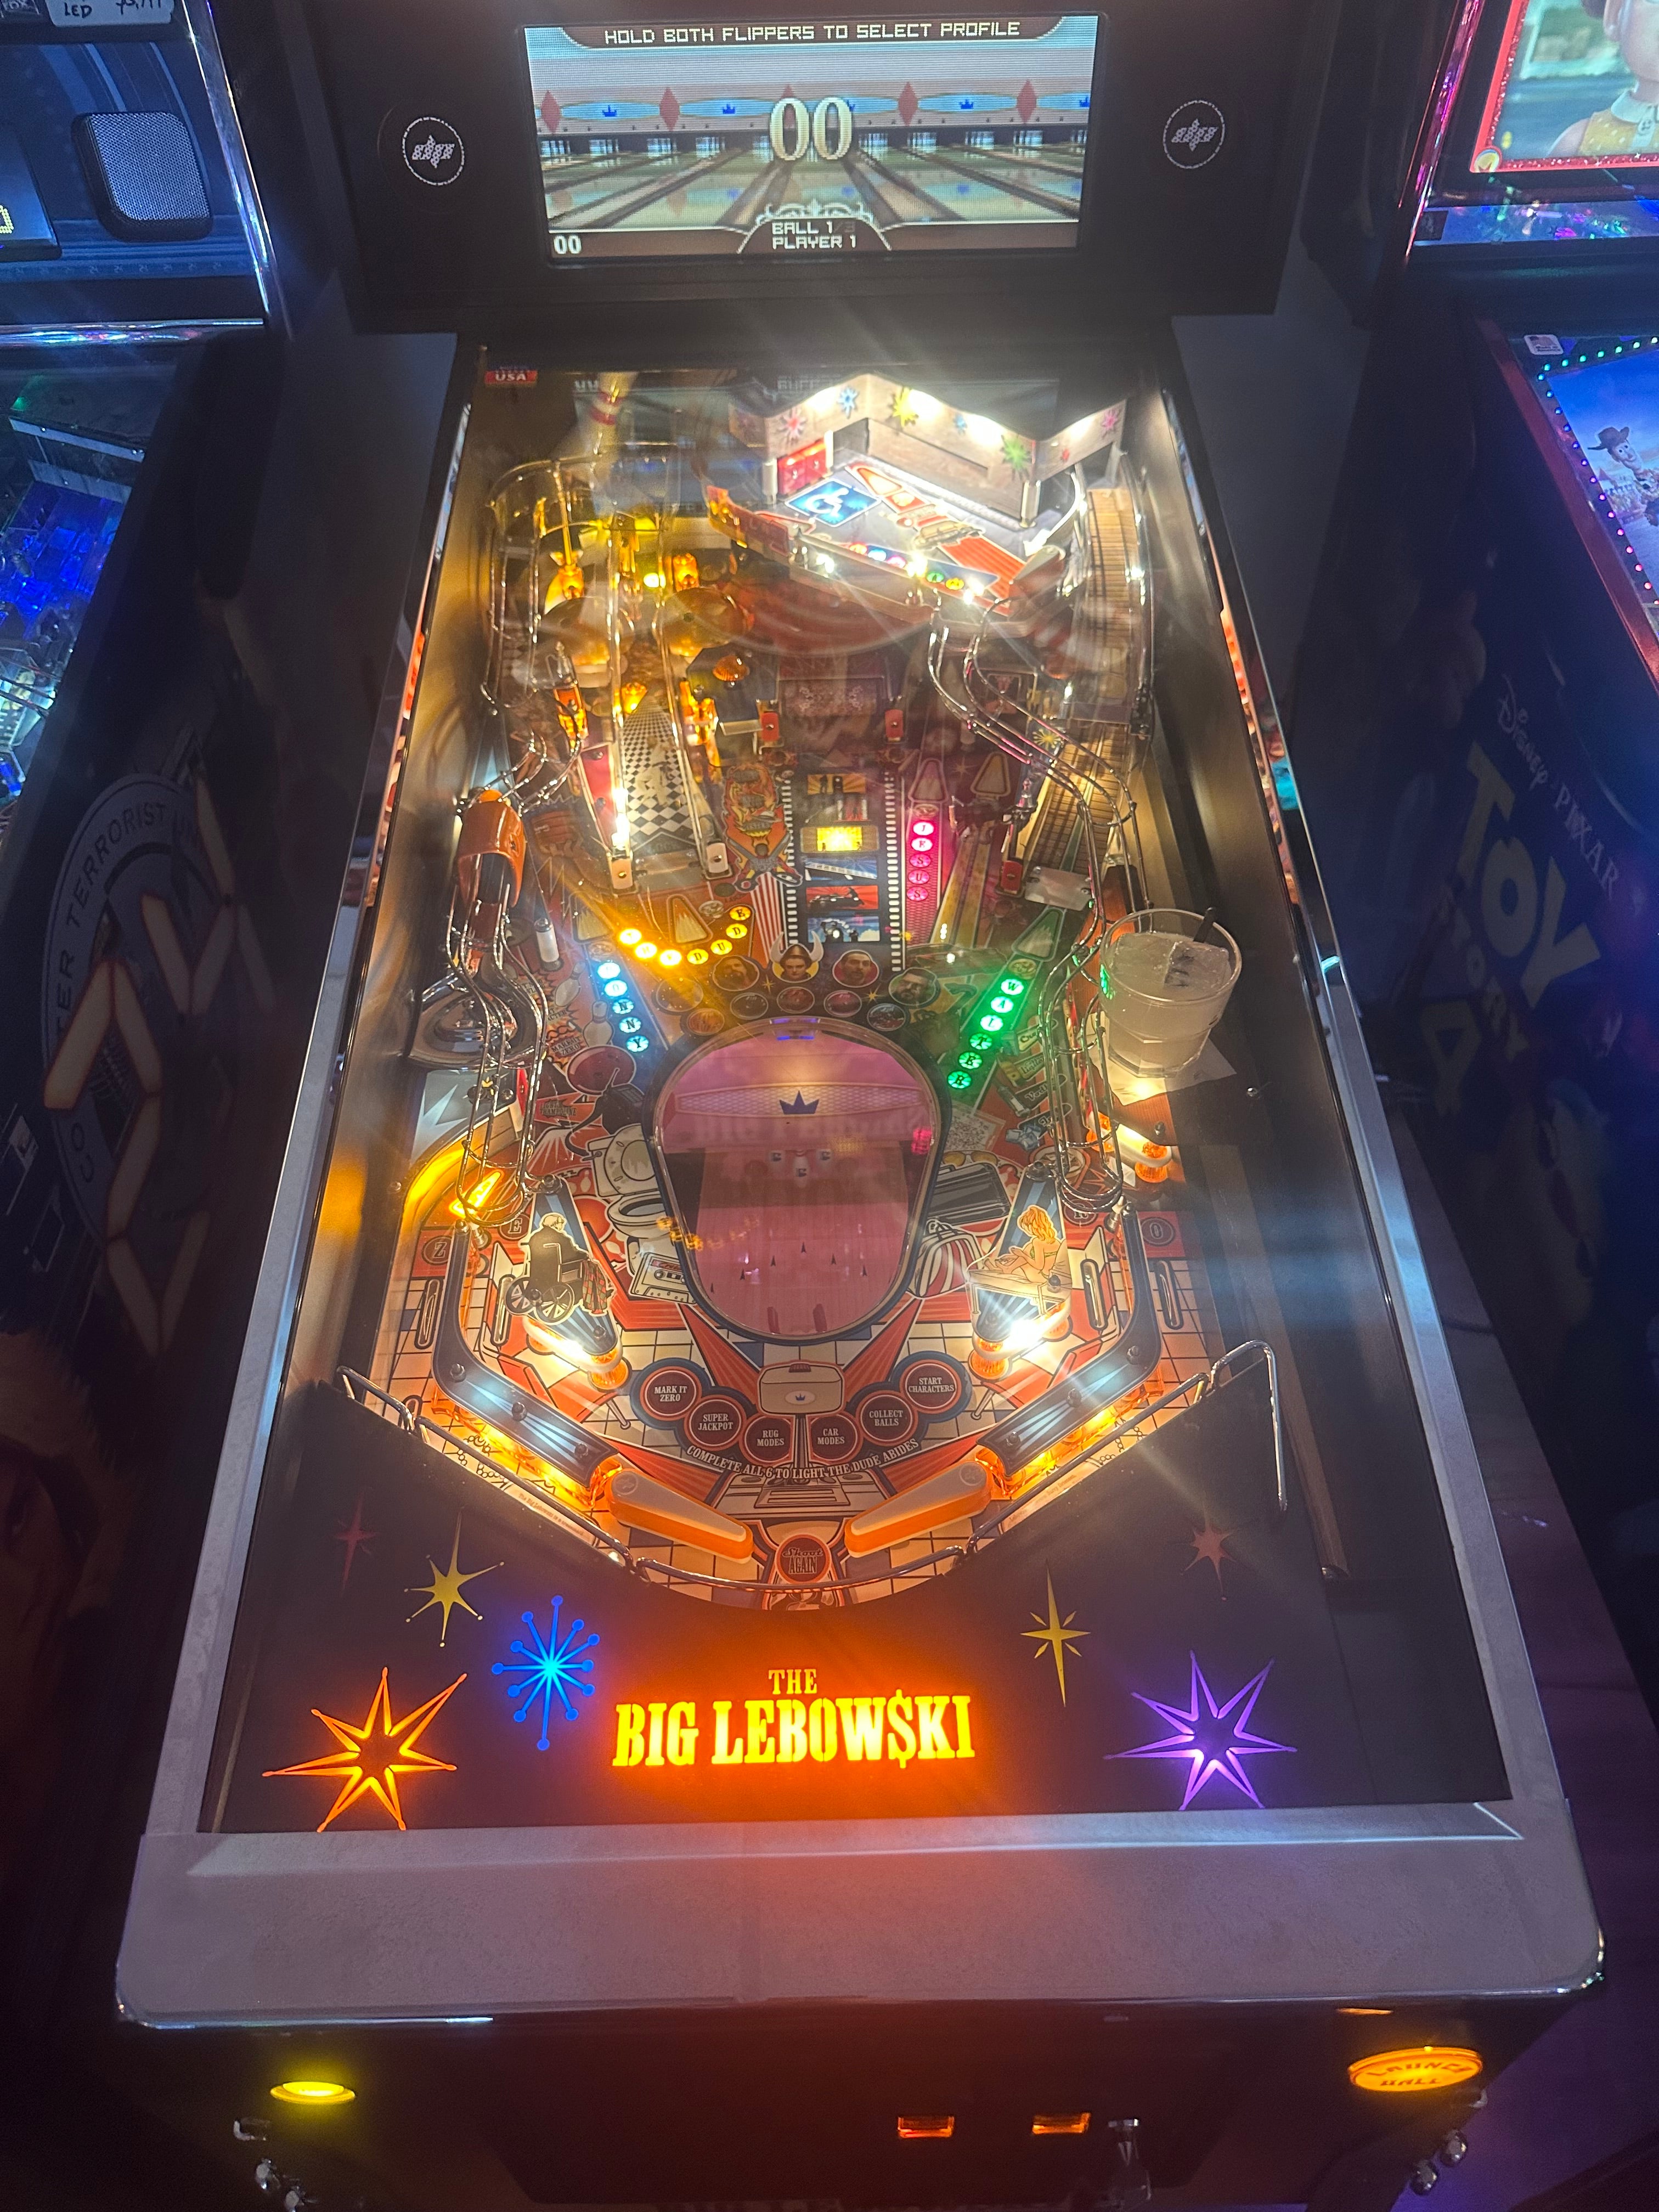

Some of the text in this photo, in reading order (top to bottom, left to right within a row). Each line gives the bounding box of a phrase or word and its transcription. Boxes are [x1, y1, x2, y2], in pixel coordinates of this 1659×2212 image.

[64, 4, 92, 18] LED
[605, 22, 1020, 44] HOLD BOTH FLIPPERS TO SELECT PROFILE
[769, 97, 852, 161] 00
[772, 221, 819, 234] BALL
[554, 235, 582, 254] 00
[772, 234, 856, 250] PLAYER 1
[1555, 782, 1619, 901] PIXAR
[65, 801, 166, 928] TERRORIST
[1455, 741, 1601, 1009] TOY
[507, 1217, 523, 1234] E
[433, 1242, 447, 1259] Z
[909, 1385, 954, 1393] CHARACTERS
[703, 1414, 729, 1422] SUPER
[869, 1410, 904, 1418] COLLECT
[874, 1418, 899, 1426] BALLS
[698, 1422, 733, 1431] JACKPOT
[763, 1430, 778, 1438] RUG
[757, 1438, 785, 1447] MODES
[817, 1436, 845, 1445] MODES
[687, 1438, 919, 1479] COMPLETE ALL 6 TO LIGHT THE DUDE ABIDES
[782, 1547, 823, 1558] Shoot
[788, 1556, 817, 1574] AGAIN
[769, 1669, 817, 1695] THE
[612, 1689, 975, 1769] BIG LEBOW$KI
